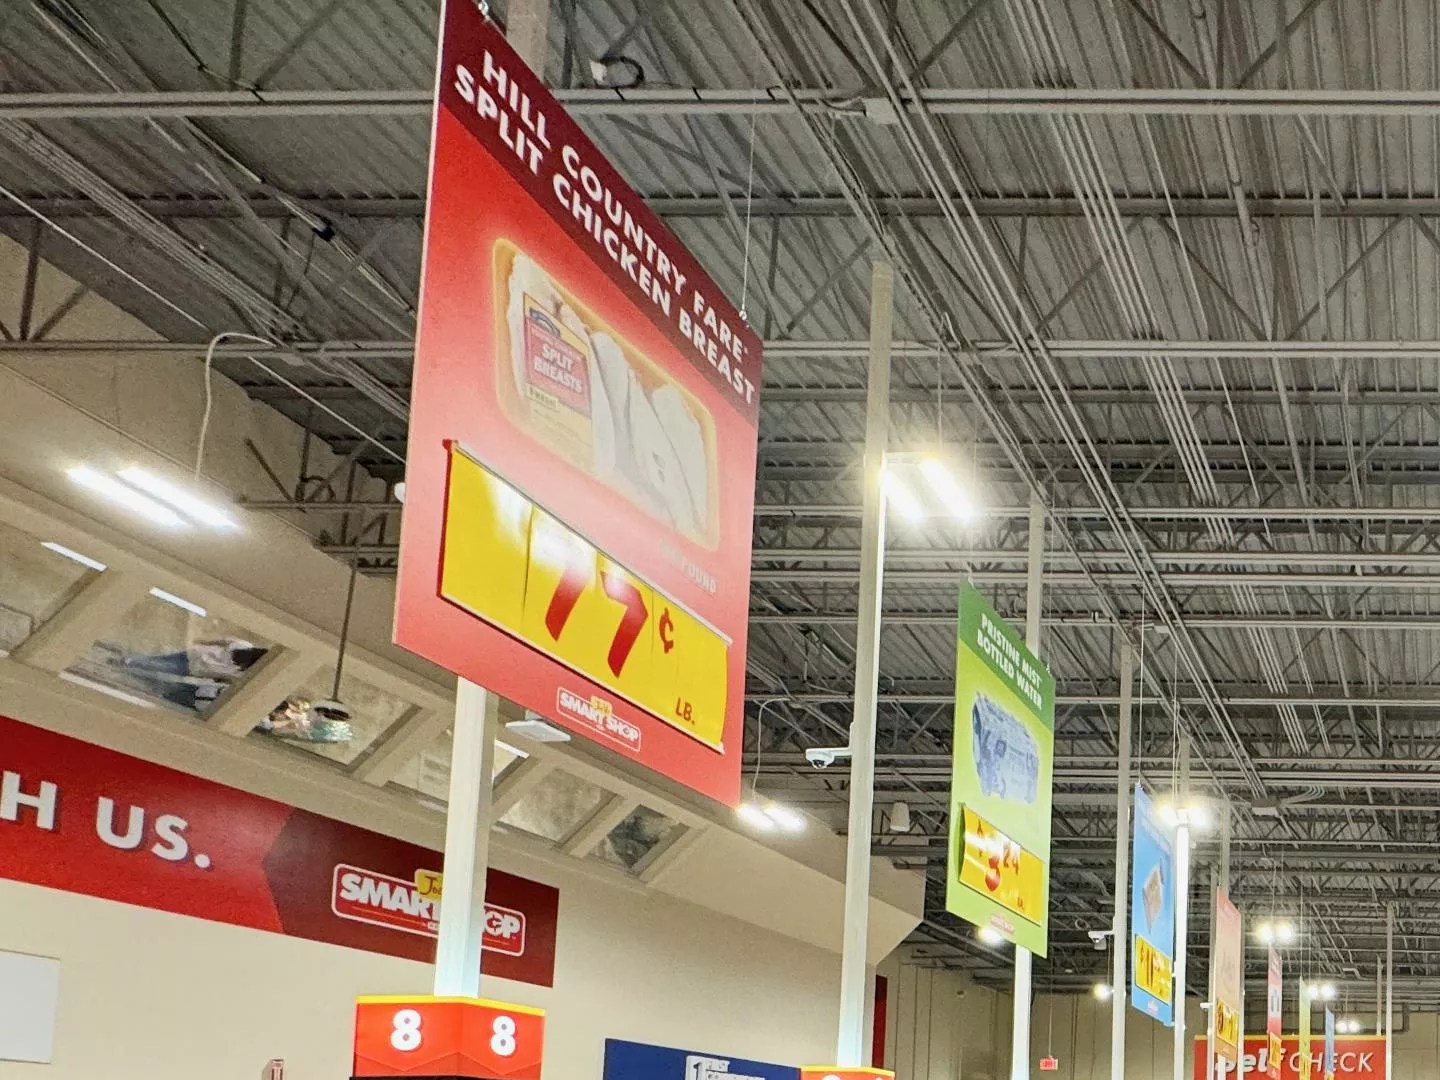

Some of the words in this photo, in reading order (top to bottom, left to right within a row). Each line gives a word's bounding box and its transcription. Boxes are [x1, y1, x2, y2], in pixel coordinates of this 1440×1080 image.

[483, 50, 551, 148] HILL
[562, 146, 687, 296] COUNTRY
[454, 64, 544, 176] SPLIT
[553, 173, 671, 316] CHICKEN
[679, 308, 755, 404] BREAST
[542, 343, 575, 371] SPLIT
[977, 628, 1014, 679] BOTTLED
[1016, 670, 1042, 710] WATER
[982, 613, 1020, 667] PRISTINE
[1022, 659, 1041, 689] MIST
[675, 697, 695, 726] LB.
[96, 796, 211, 869] US.
[483, 909, 521, 939] OP
[390, 1008, 423, 1052] 8
[491, 1015, 517, 1057] 8
